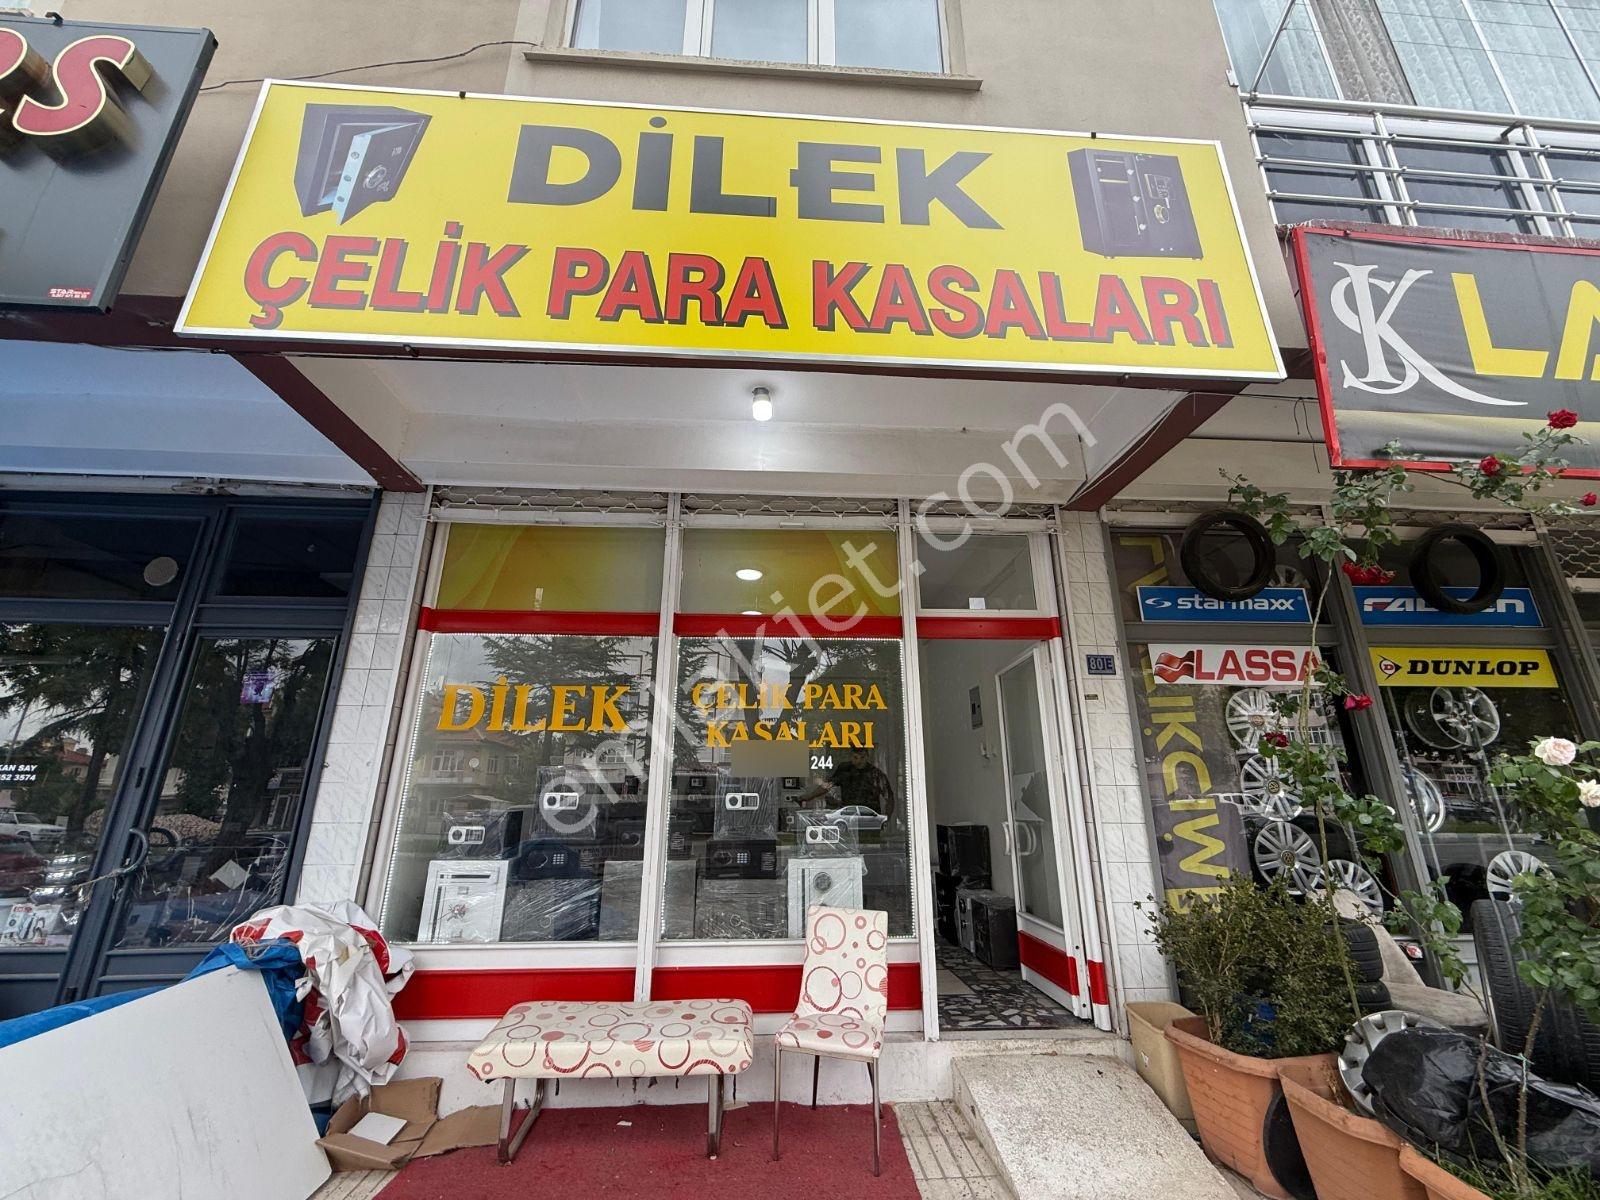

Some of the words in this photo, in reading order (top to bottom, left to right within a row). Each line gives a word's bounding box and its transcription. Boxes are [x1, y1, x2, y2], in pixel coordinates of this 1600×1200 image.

[506, 116, 1006, 231] DİLEK
[243, 220, 534, 331] ÇELİK
[546, 246, 790, 330] PARA
[811, 259, 1234, 348] KASALARI
[1195, 649, 1322, 682] LASSA
[1406, 659, 1540, 676] DUNLOP
[436, 675, 632, 732] DİLEK
[691, 682, 794, 716] ÇELİK
[803, 683, 888, 710] PARA
[707, 720, 876, 748] KASALARI
[17, 764, 39, 772] SAY
[810, 755, 834, 770] 244
